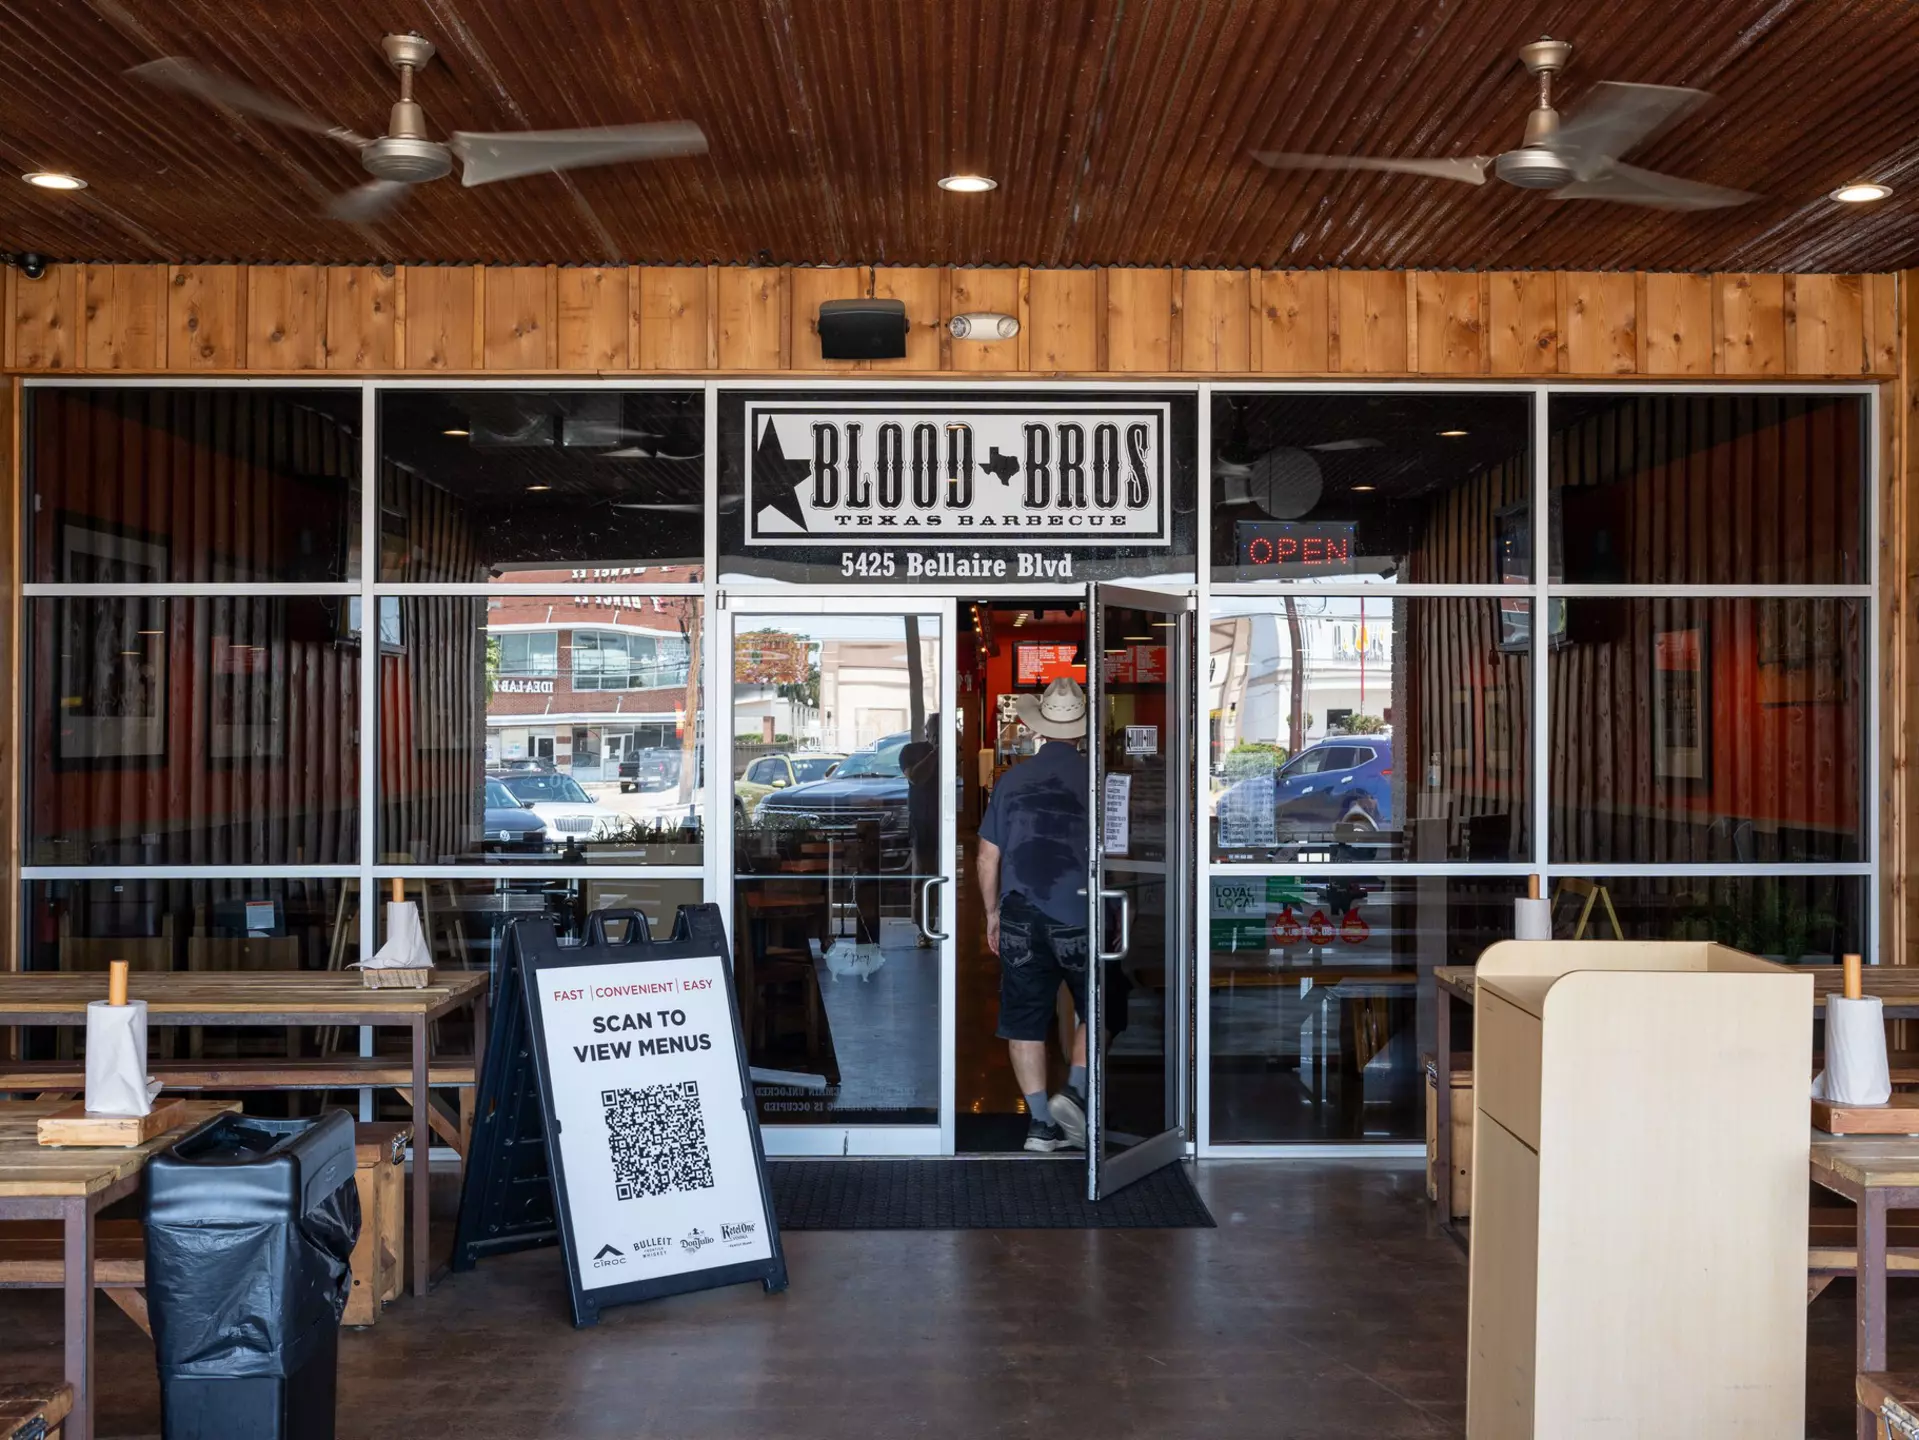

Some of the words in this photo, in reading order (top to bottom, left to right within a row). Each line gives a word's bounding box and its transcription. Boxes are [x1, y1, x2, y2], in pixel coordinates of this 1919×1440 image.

[810, 420, 976, 511] BLOOD
[1022, 420, 1152, 511] BROS
[834, 515, 942, 526] TEXAS
[958, 515, 1128, 526] BARBECUE
[1250, 537, 1347, 564] OPEN
[841, 552, 896, 577] 5425
[907, 552, 1007, 577] Bellaire
[1017, 552, 1073, 577] Blvd
[554, 989, 584, 1001] FAST
[595, 982, 674, 998] CONVENIENT
[683, 979, 713, 991] EASY
[592, 1012, 653, 1034] SCAN
[657, 1009, 686, 1027] TO
[573, 1041, 632, 1063] VIEW
[638, 1033, 712, 1056] MENUS
[633, 1237, 672, 1251] BULLEIT
